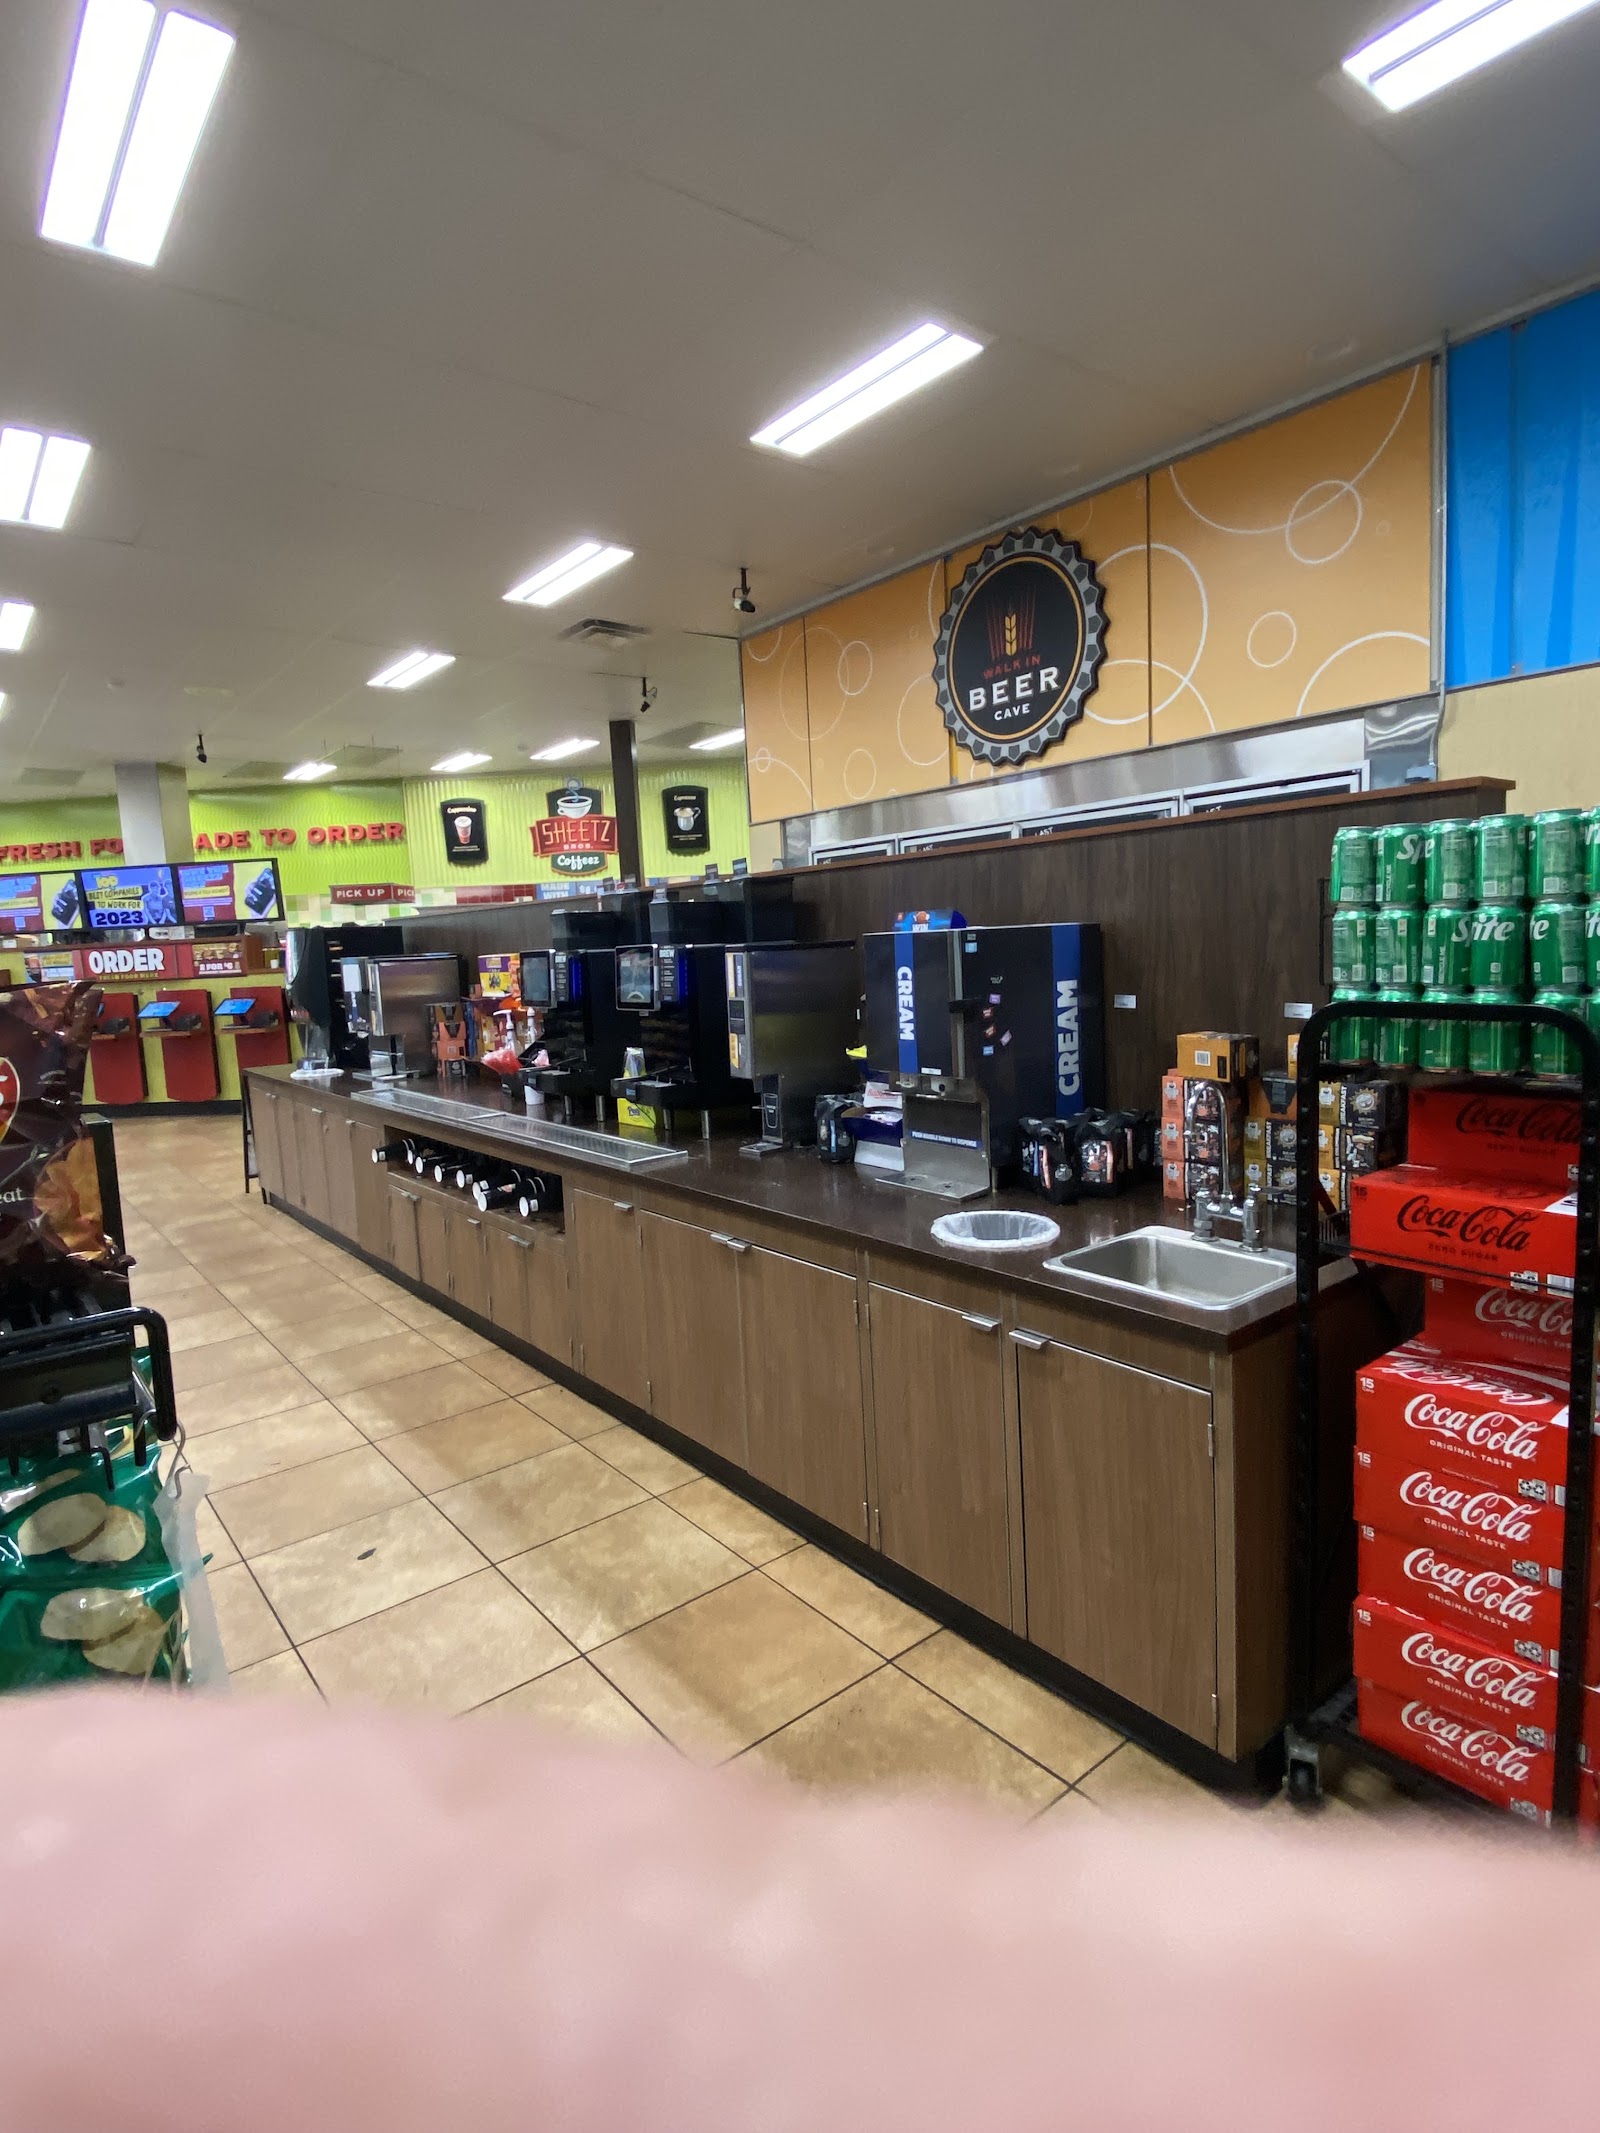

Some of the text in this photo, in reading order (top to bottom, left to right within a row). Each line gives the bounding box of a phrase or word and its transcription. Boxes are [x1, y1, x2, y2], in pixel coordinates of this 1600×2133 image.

[983, 654, 1042, 680] WALK IN
[969, 666, 1061, 712] BEER
[994, 702, 1031, 721] CAVE
[195, 822, 405, 849] ADE TO ORDER
[541, 819, 612, 846] SHEETZ
[90, 837, 124, 856] FO
[557, 854, 600, 871] Coffeez
[104, 887, 140, 899] COMPANIES
[336, 888, 386, 898] PICK UP
[97, 901, 141, 909] TO WORK FOR
[95, 910, 144, 926] 2023
[88, 948, 165, 974] ORDER
[897, 966, 915, 1041] CREAM
[1056, 979, 1080, 1096] CREAM
[1354, 1186, 1368, 1197] 15
[1428, 1243, 1499, 1262] ZERO SUGAR
[1501, 1330, 1548, 1346] ORIGINAL
[1360, 1377, 1375, 1389] 15
[1358, 1451, 1371, 1464] 15
[1430, 1439, 1513, 1469] ORIGINAL TASTE
[1361, 1524, 1375, 1538] 15
[1423, 1517, 1507, 1550] ORIGINAL TASTE
[1357, 1608, 1371, 1622] 15
[1427, 1592, 1509, 1630] ORIGINAL TASTE
[1426, 1677, 1511, 1714] ORIGINAL TASTE
[1425, 1744, 1506, 1788] ORIGINAL TASTE
